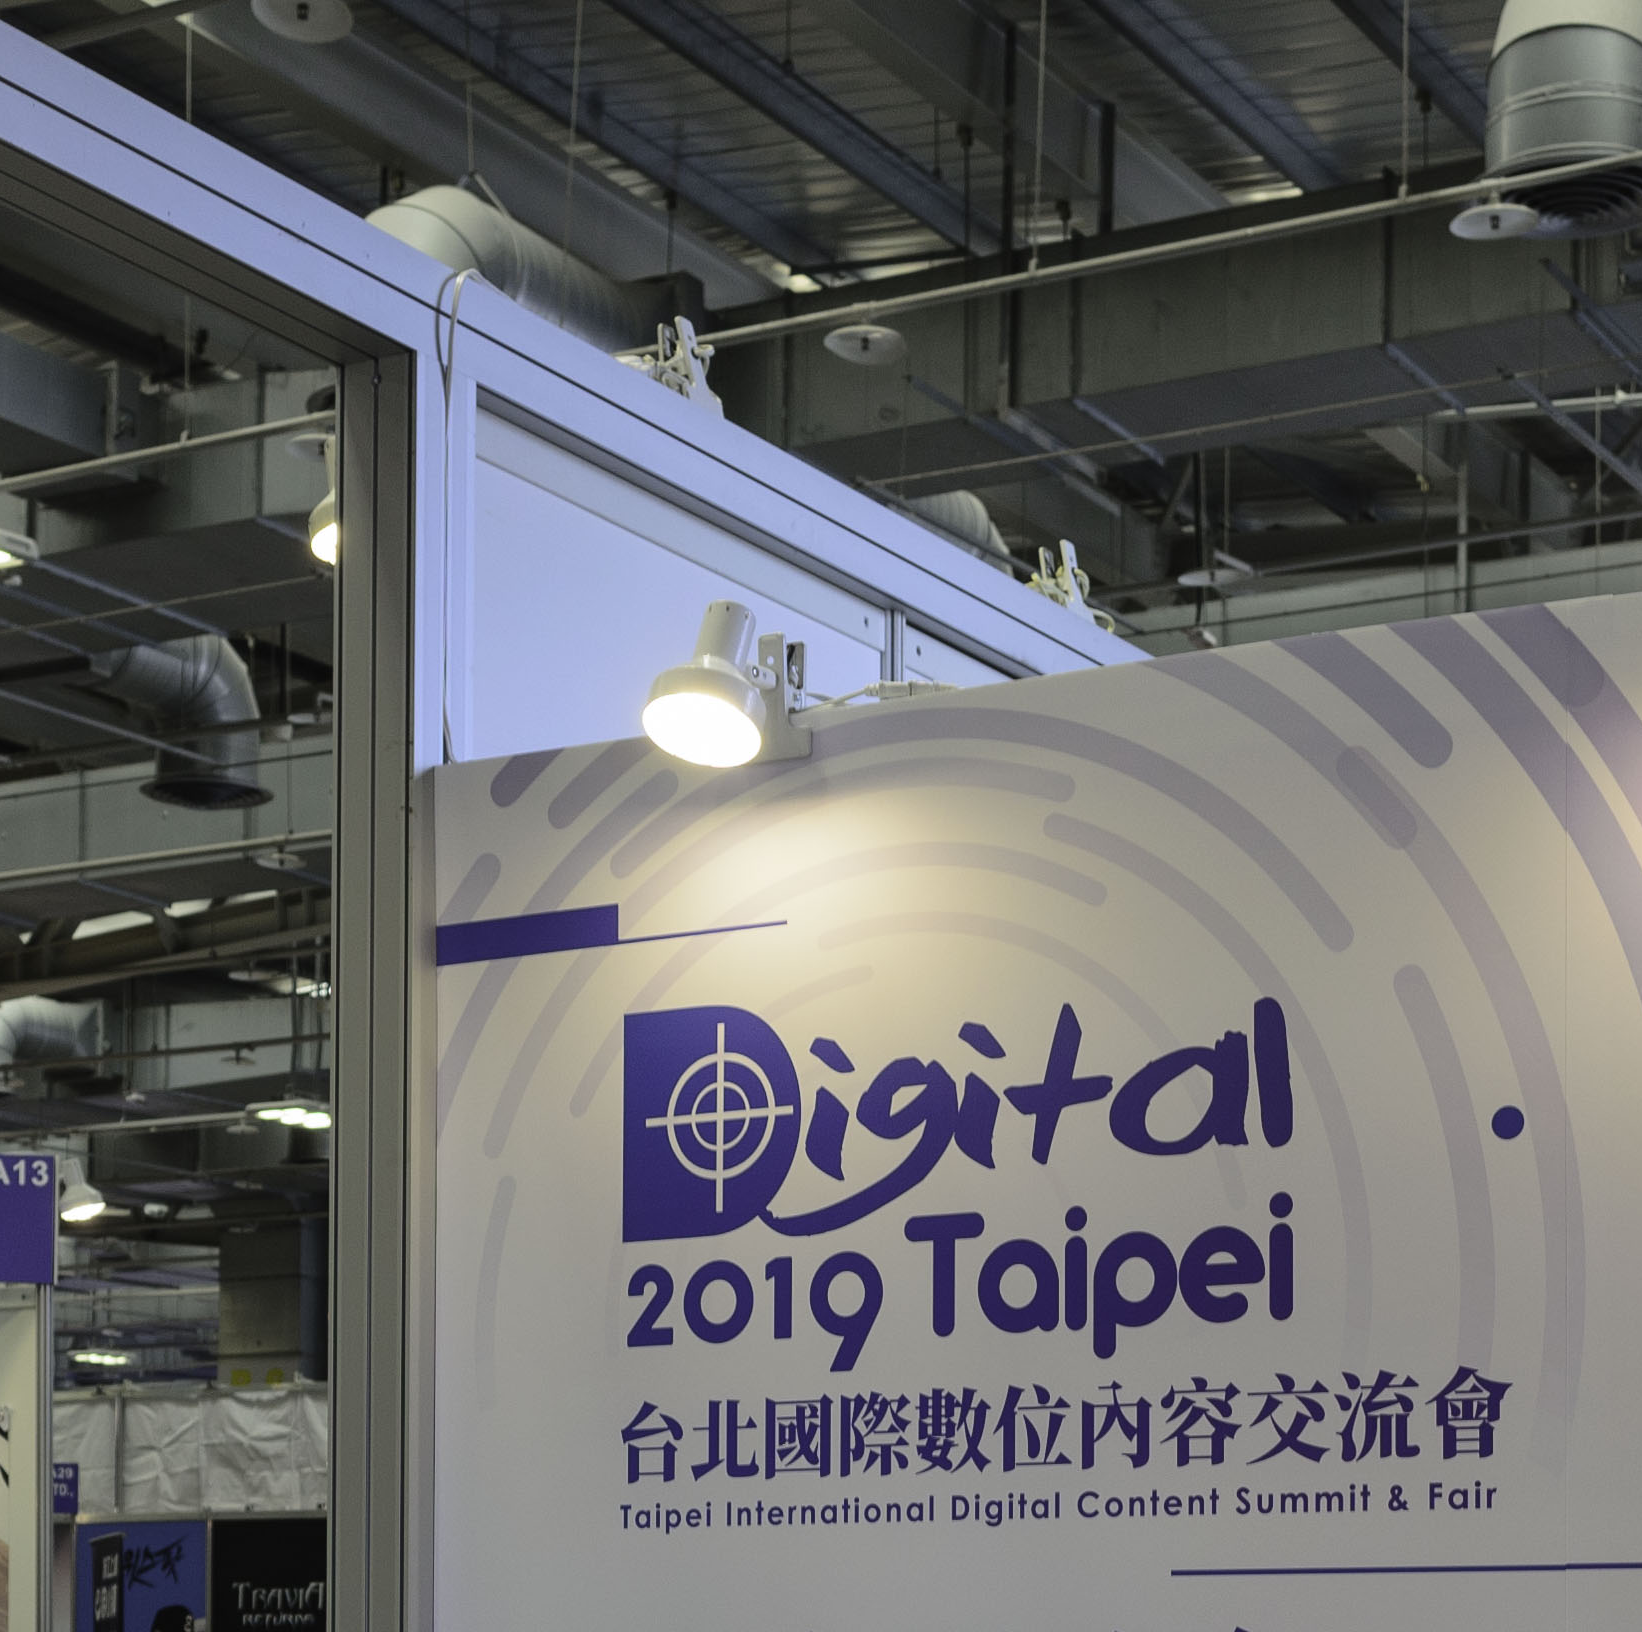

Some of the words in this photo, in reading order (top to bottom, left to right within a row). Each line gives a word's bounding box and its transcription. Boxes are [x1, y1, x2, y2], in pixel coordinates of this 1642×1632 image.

[623, 997, 1293, 1243] Digital
[627, 1251, 883, 1372] 2019
[904, 1191, 1293, 1360] Taipei
[620, 1366, 1513, 1484] 台北國際數位內容交流會
[620, 1502, 714, 1534] Taipei
[725, 1496, 936, 1527] International
[950, 1492, 1061, 1527] Digital
[1076, 1488, 1221, 1519] Content
[1235, 1482, 1371, 1515] Summit
[1387, 1486, 1409, 1511] &
[1428, 1481, 1499, 1511] Fair
